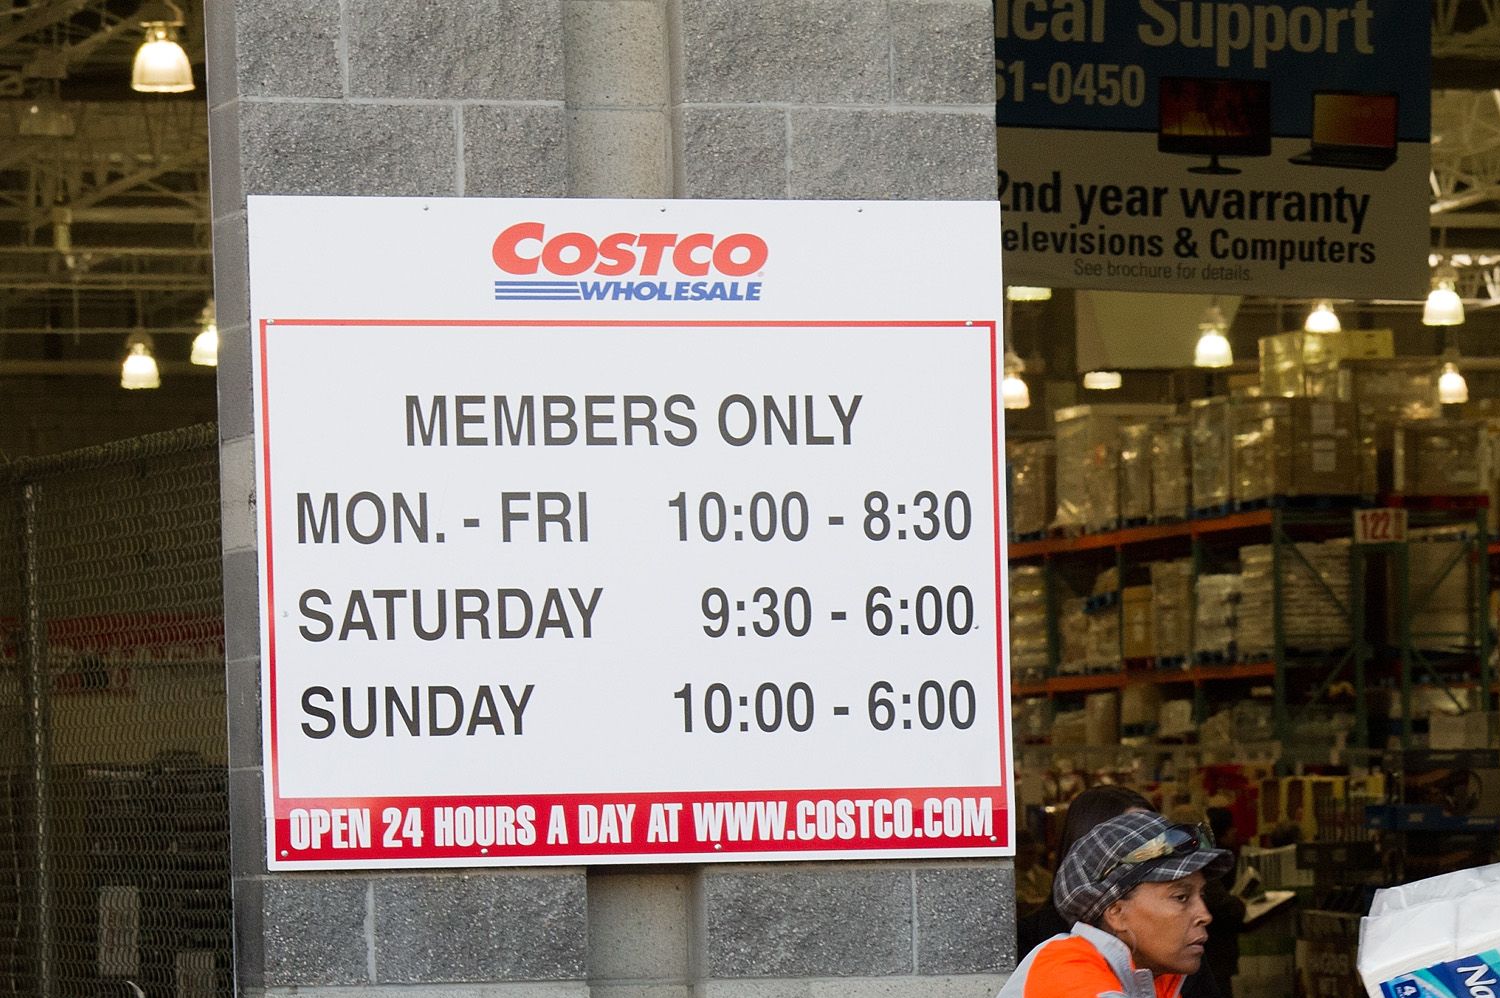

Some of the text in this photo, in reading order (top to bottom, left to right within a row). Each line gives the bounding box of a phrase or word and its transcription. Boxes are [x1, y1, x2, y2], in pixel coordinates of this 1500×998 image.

[1137, 0, 1375, 68] Support
[998, 169, 1370, 234] 2nd year warranty
[492, 222, 769, 276] COSTCO
[1002, 222, 1375, 270] elevisions & Computers
[1074, 258, 1103, 276] See
[1107, 259, 1172, 279] brochure
[1177, 263, 1197, 280] for
[580, 281, 763, 301] WHOLESALE
[406, 394, 863, 446] MEMBERS ONLY
[297, 492, 445, 544] MON.
[502, 491, 589, 543] FRI
[669, 491, 809, 542] 10:00
[864, 490, 972, 542] 8:30
[299, 588, 603, 642] SATURDAY
[702, 587, 812, 639] 9:30
[866, 585, 974, 637] 6:00
[300, 684, 536, 740] SUNDAY
[674, 682, 815, 734] 10:00
[868, 680, 976, 732] 6:00
[289, 796, 994, 851] OPEN 24 HOURS A DAY AT WWW.COSTCO.COM
[1403, 985, 1417, 996] 4
